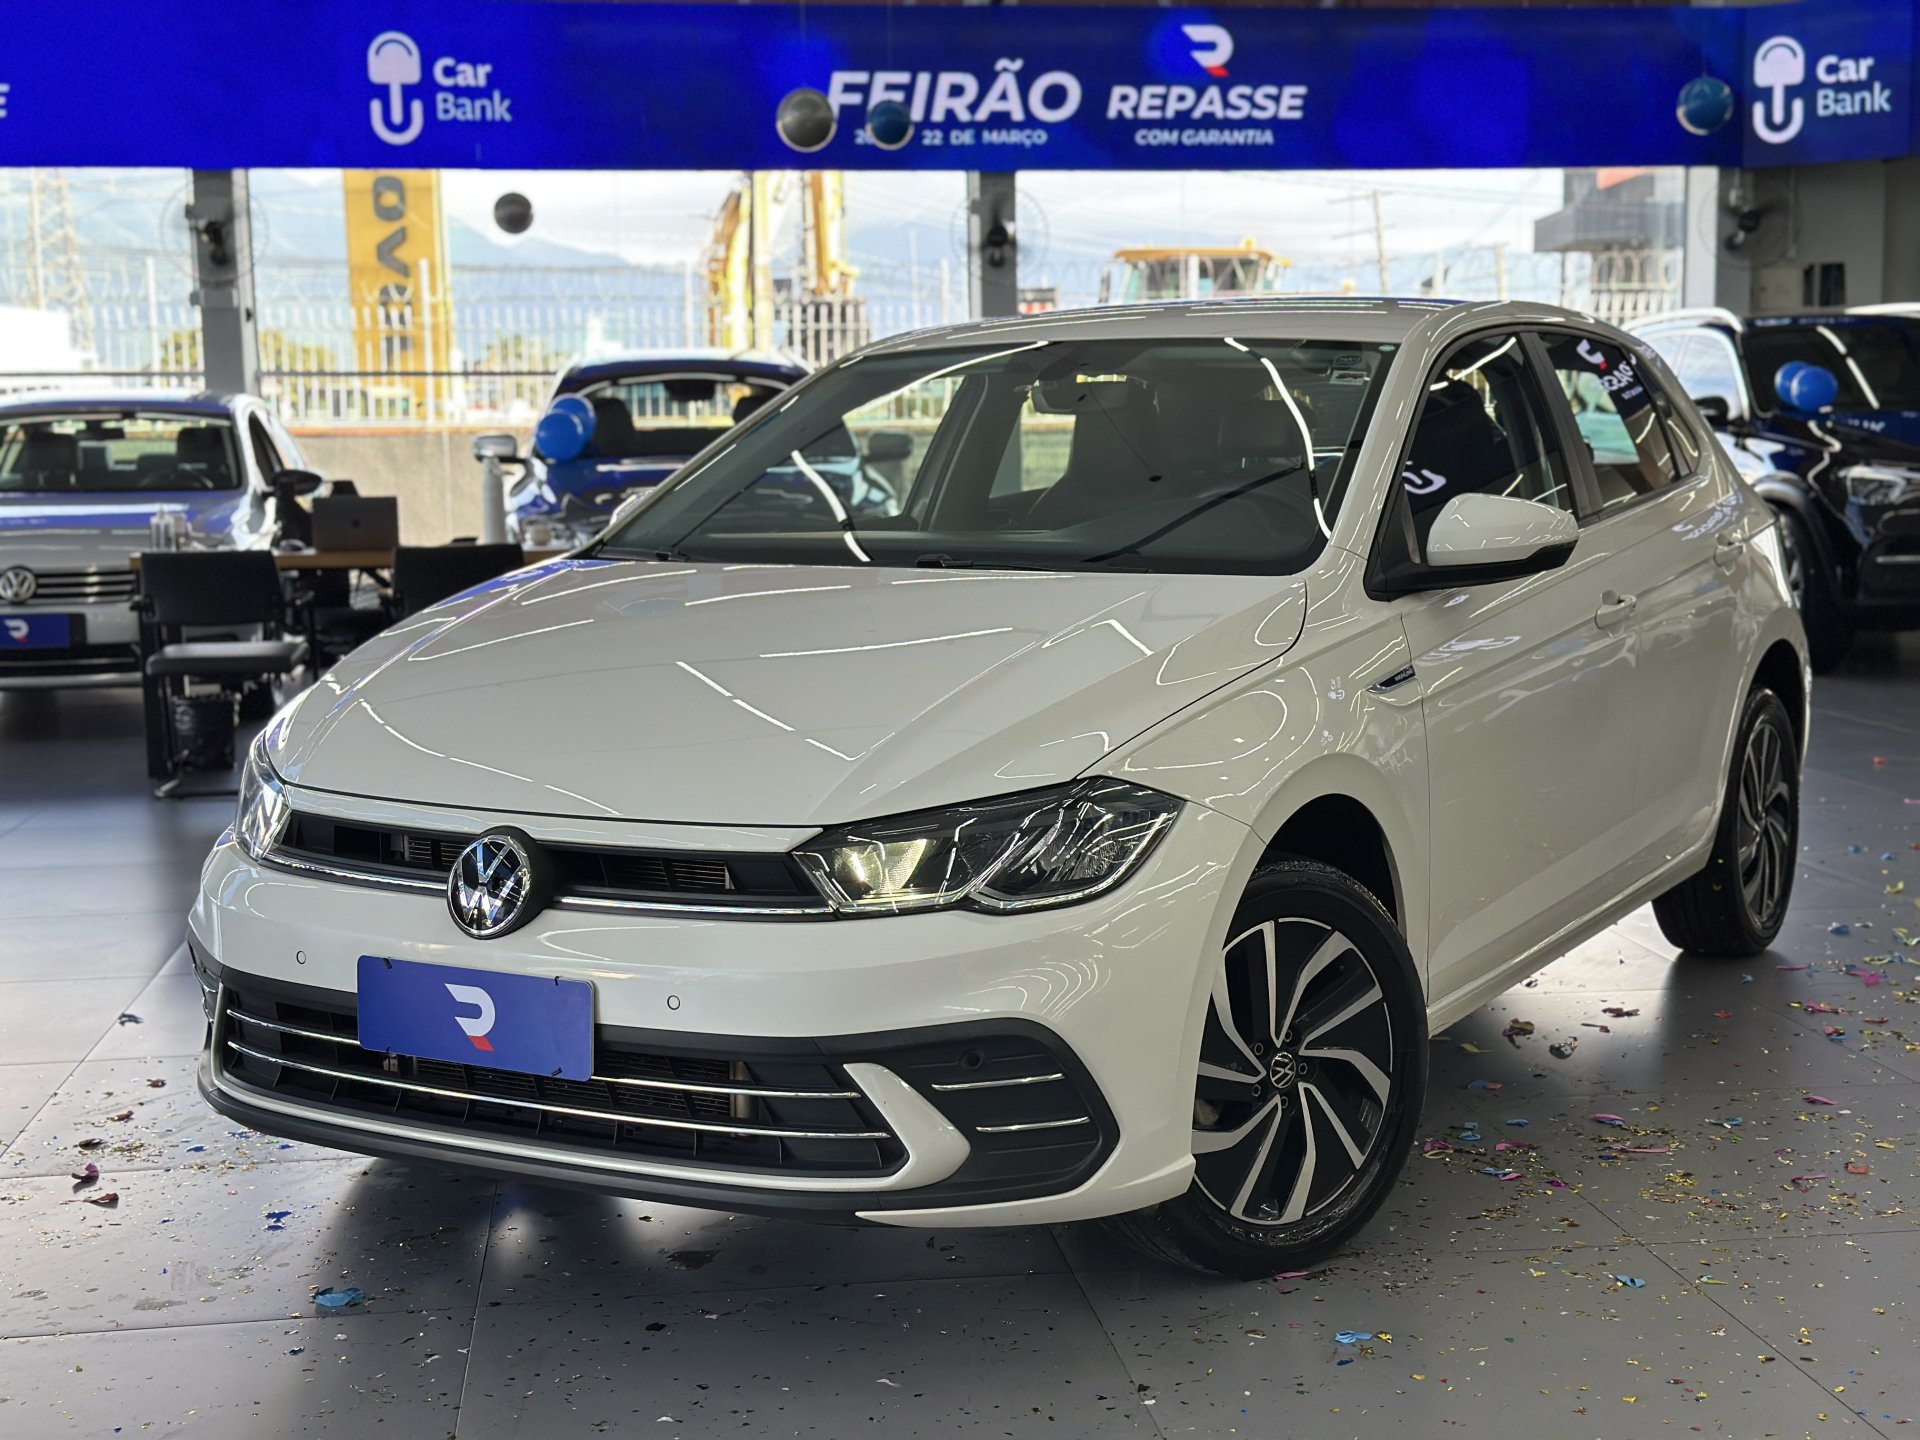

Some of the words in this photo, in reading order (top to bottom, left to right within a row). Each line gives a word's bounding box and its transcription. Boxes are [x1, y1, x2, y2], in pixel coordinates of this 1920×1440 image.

[433, 57, 493, 88] Car
[1815, 55, 1875, 83] Car
[436, 89, 512, 122] Bank
[1106, 85, 1308, 120] REPASSE
[1816, 81, 1892, 117] Bank
[922, 129, 943, 146] 22
[951, 129, 975, 146] DE
[982, 128, 1048, 148] MARÇO
[1134, 128, 1179, 146] COM
[1181, 128, 1274, 146] GARANTIA
